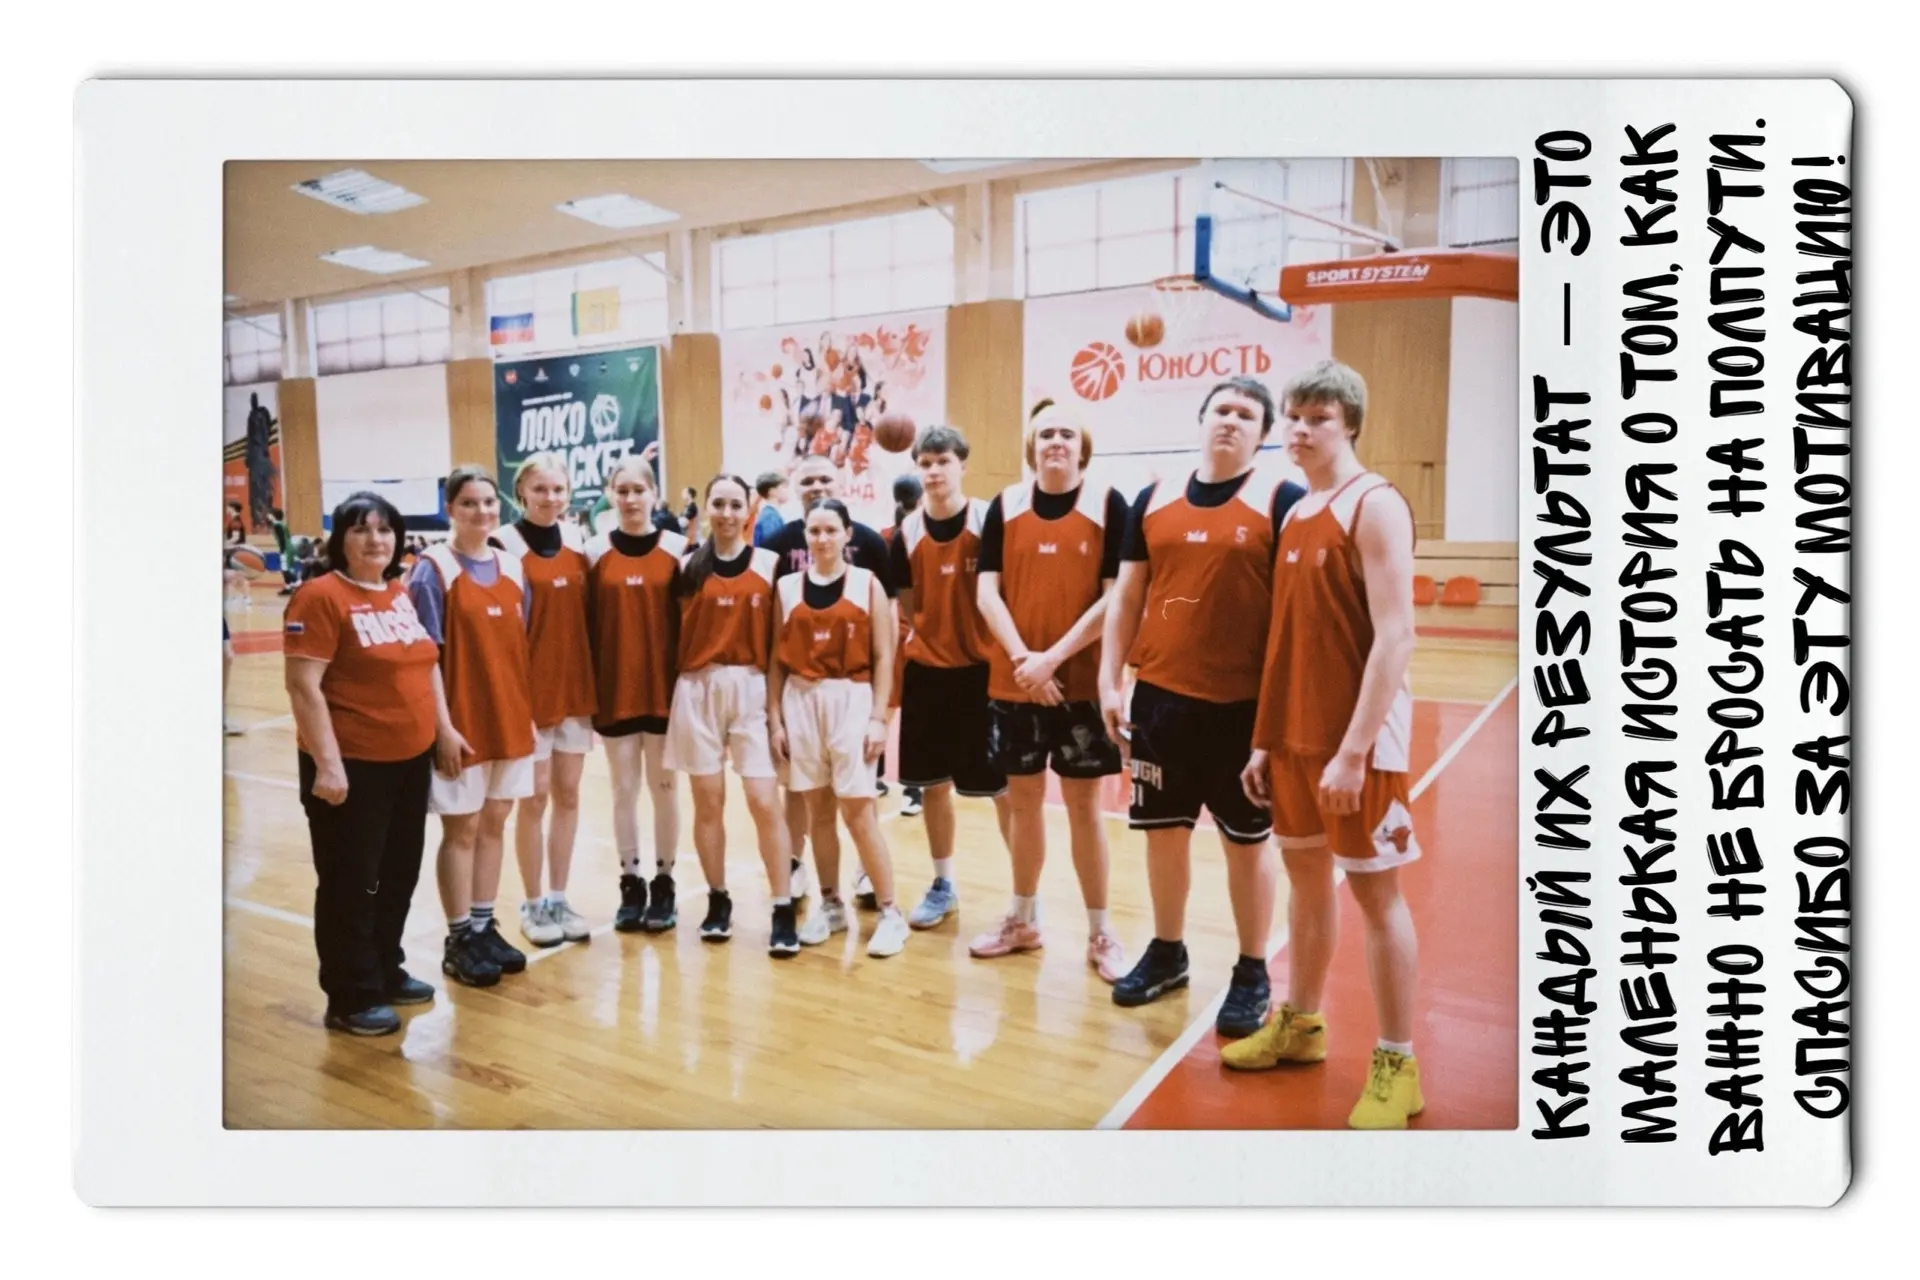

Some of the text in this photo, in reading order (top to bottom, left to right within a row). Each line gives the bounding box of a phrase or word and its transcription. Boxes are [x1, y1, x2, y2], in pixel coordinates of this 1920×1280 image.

[1306, 263, 1431, 284] SPORT SYSTEM
[517, 401, 586, 452] ЛОКО
[1235, 525, 1249, 544] 5
